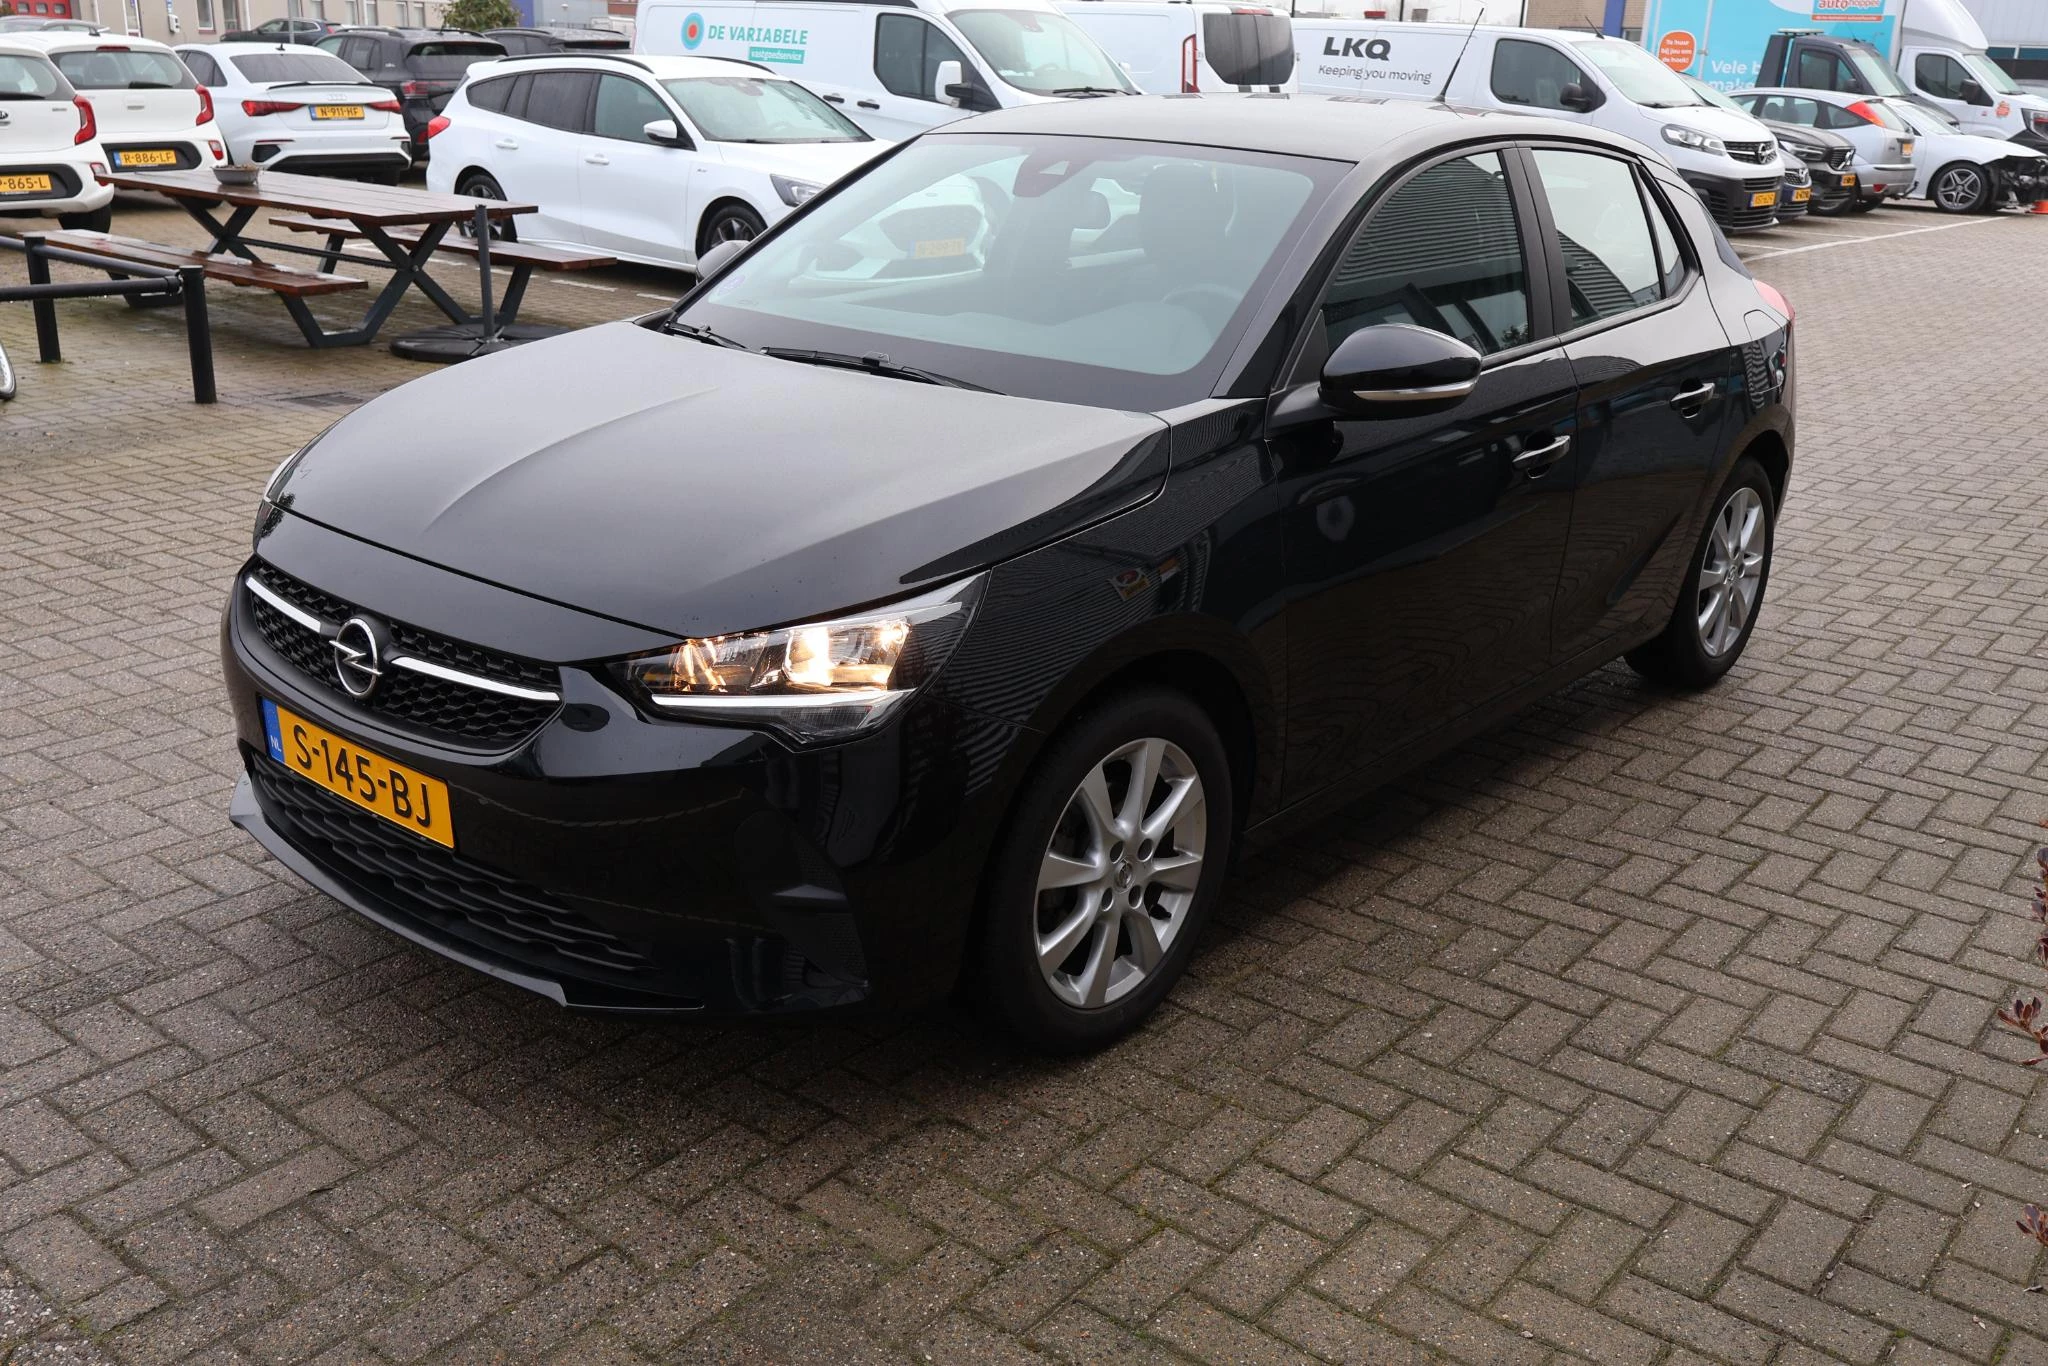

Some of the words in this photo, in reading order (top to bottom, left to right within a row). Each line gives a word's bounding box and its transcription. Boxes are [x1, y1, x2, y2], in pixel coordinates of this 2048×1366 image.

[708, 25, 725, 40] DE
[730, 26, 808, 45] VARIABELE
[1323, 36, 1391, 61] LKQ
[1318, 65, 1363, 80] Keeping
[1364, 70, 1386, 80] you
[1388, 70, 1432, 85] moving
[1711, 60, 1747, 74] Vele
[320, 106, 359, 116] N-911-HF
[123, 152, 173, 164] R-886-LF
[0, 177, 47, 189] -865-L
[270, 735, 282, 752] NL
[293, 724, 431, 828] S-145-BJ
